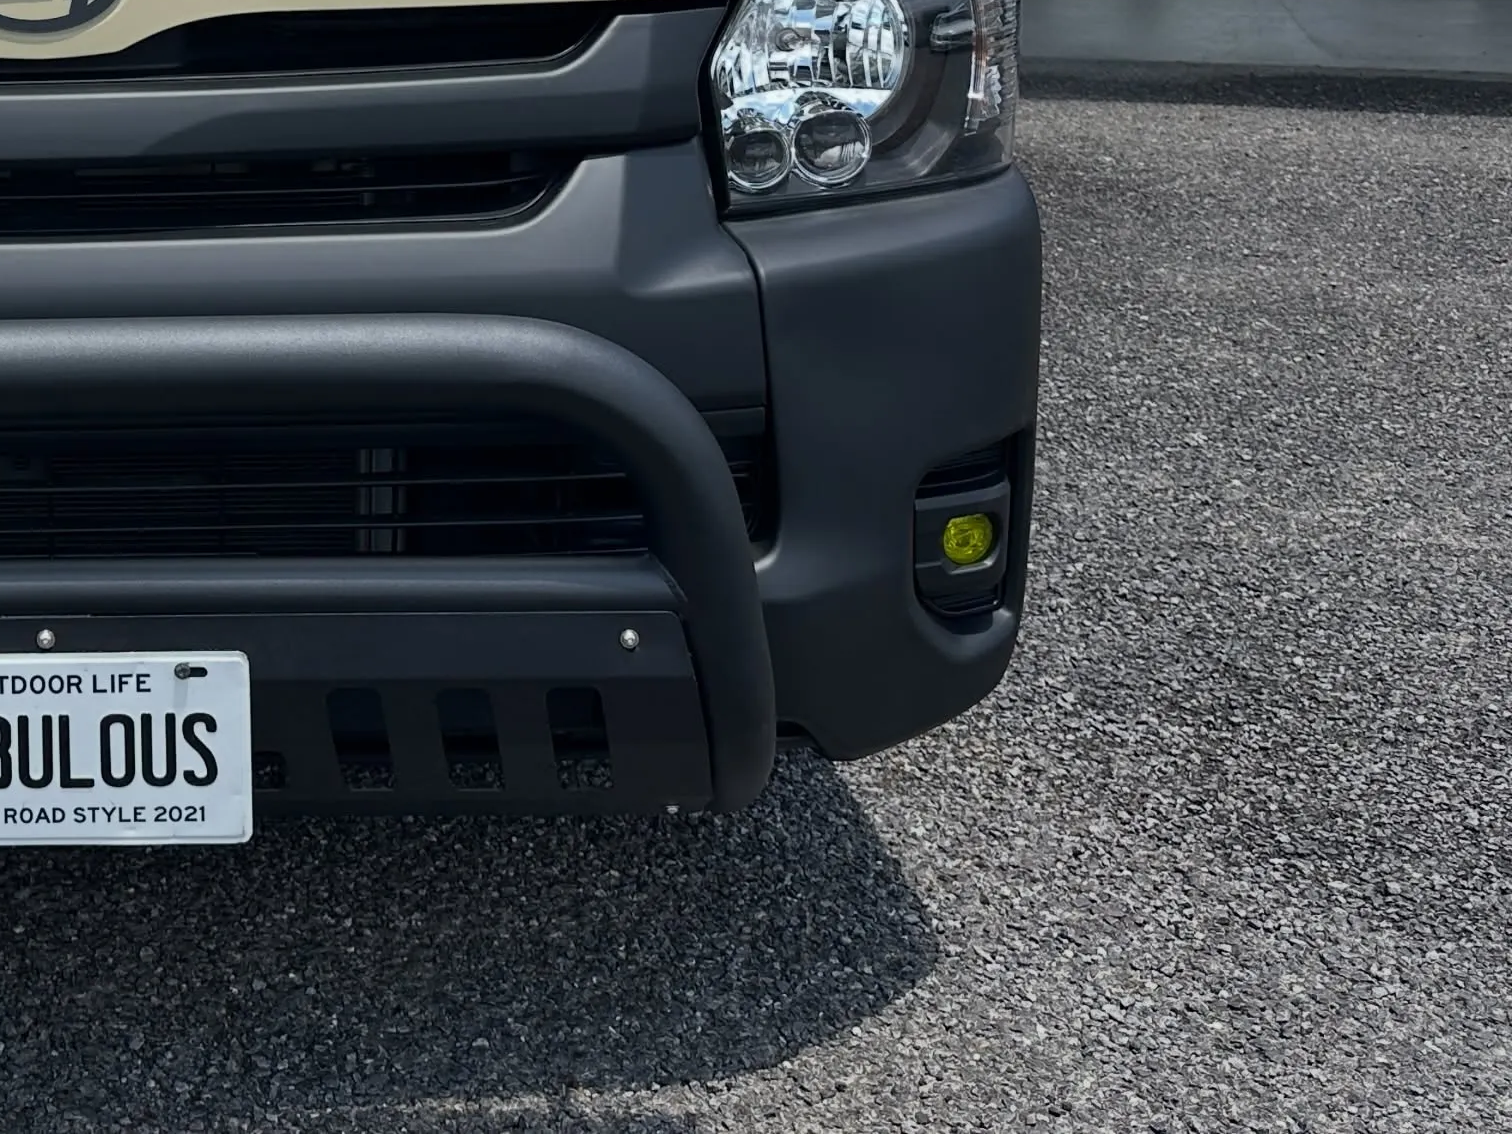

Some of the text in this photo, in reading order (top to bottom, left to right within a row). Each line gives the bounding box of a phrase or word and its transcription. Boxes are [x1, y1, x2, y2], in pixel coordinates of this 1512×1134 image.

[92, 674, 152, 693] LIFE
[3, 808, 66, 824] ROAD
[73, 807, 146, 823] STYLE
[153, 806, 206, 822] 2021
